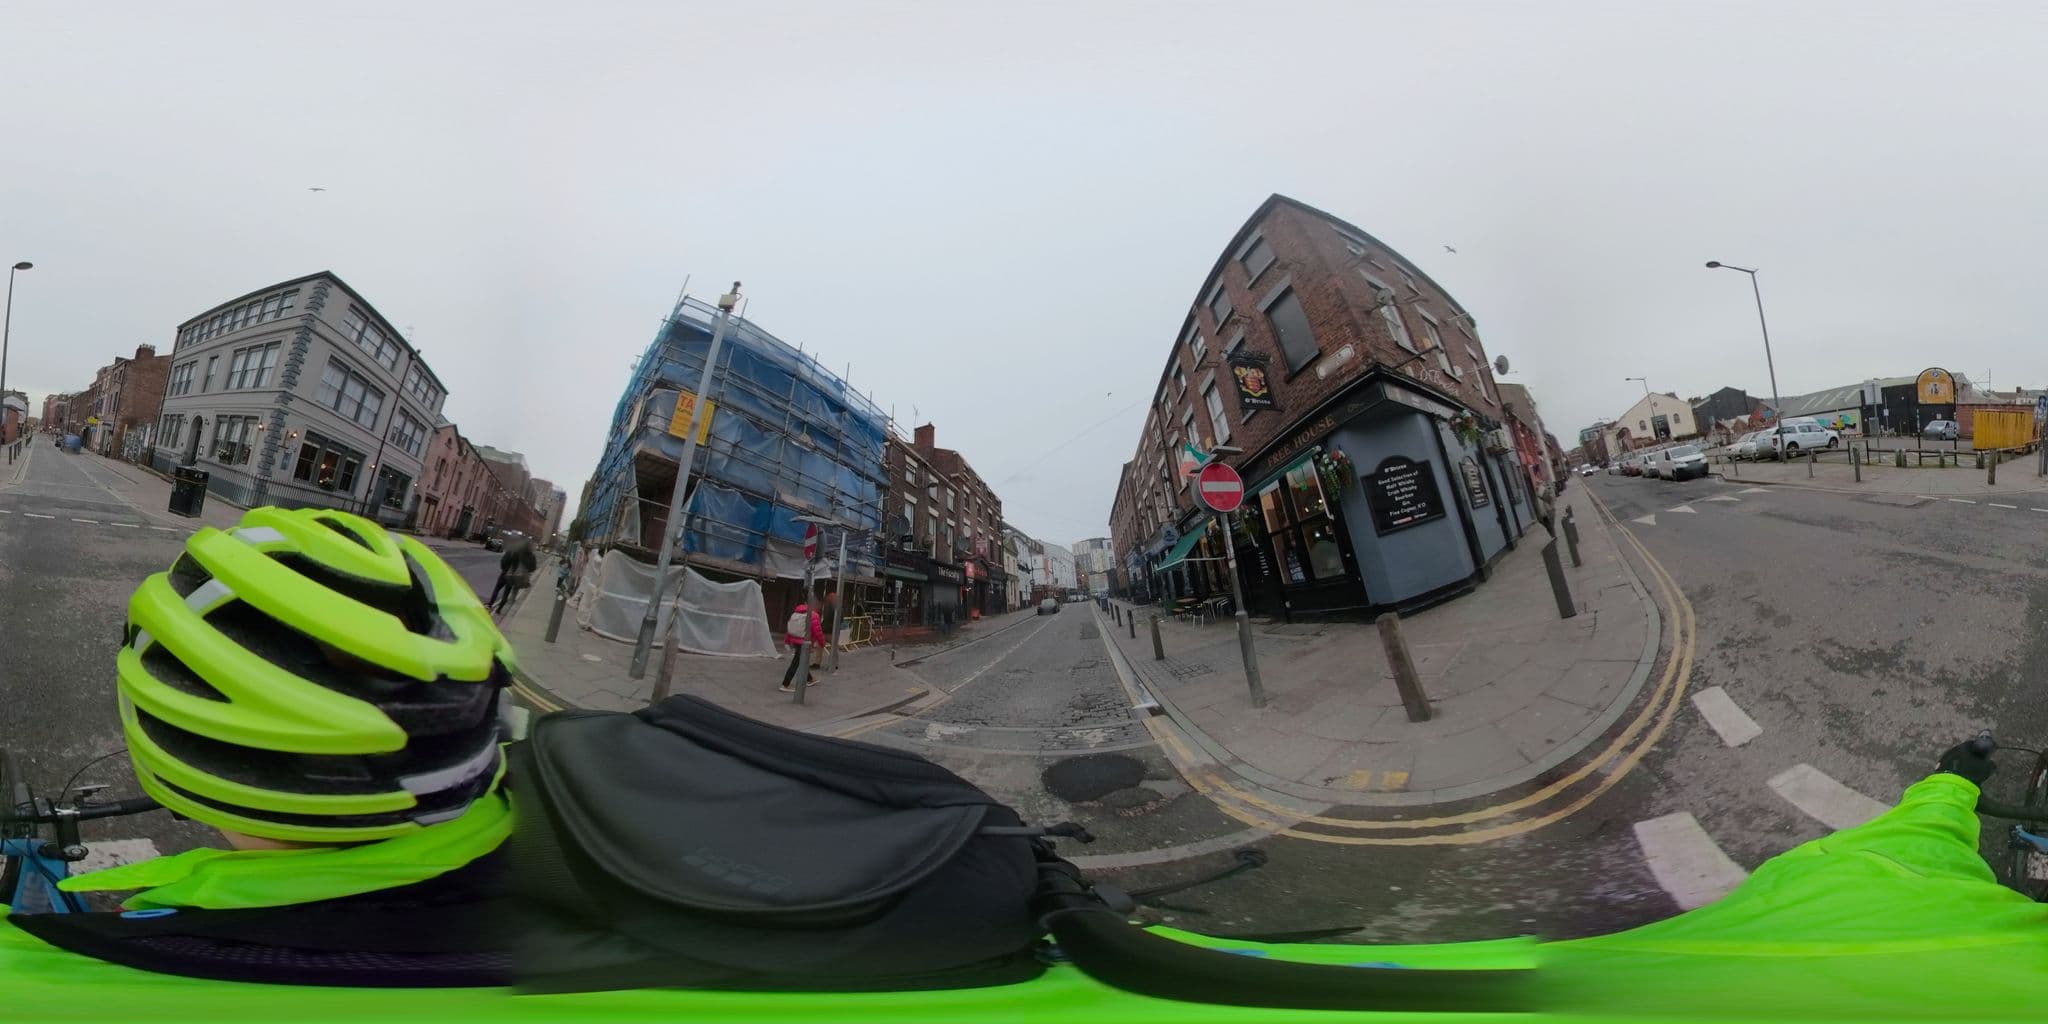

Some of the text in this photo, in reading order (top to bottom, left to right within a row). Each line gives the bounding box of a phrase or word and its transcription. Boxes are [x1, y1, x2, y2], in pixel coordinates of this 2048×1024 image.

[1268, 416, 1336, 467] FREE HOUSE
[1391, 473, 1412, 481] Selection
[1395, 493, 1414, 501] Bourbon
